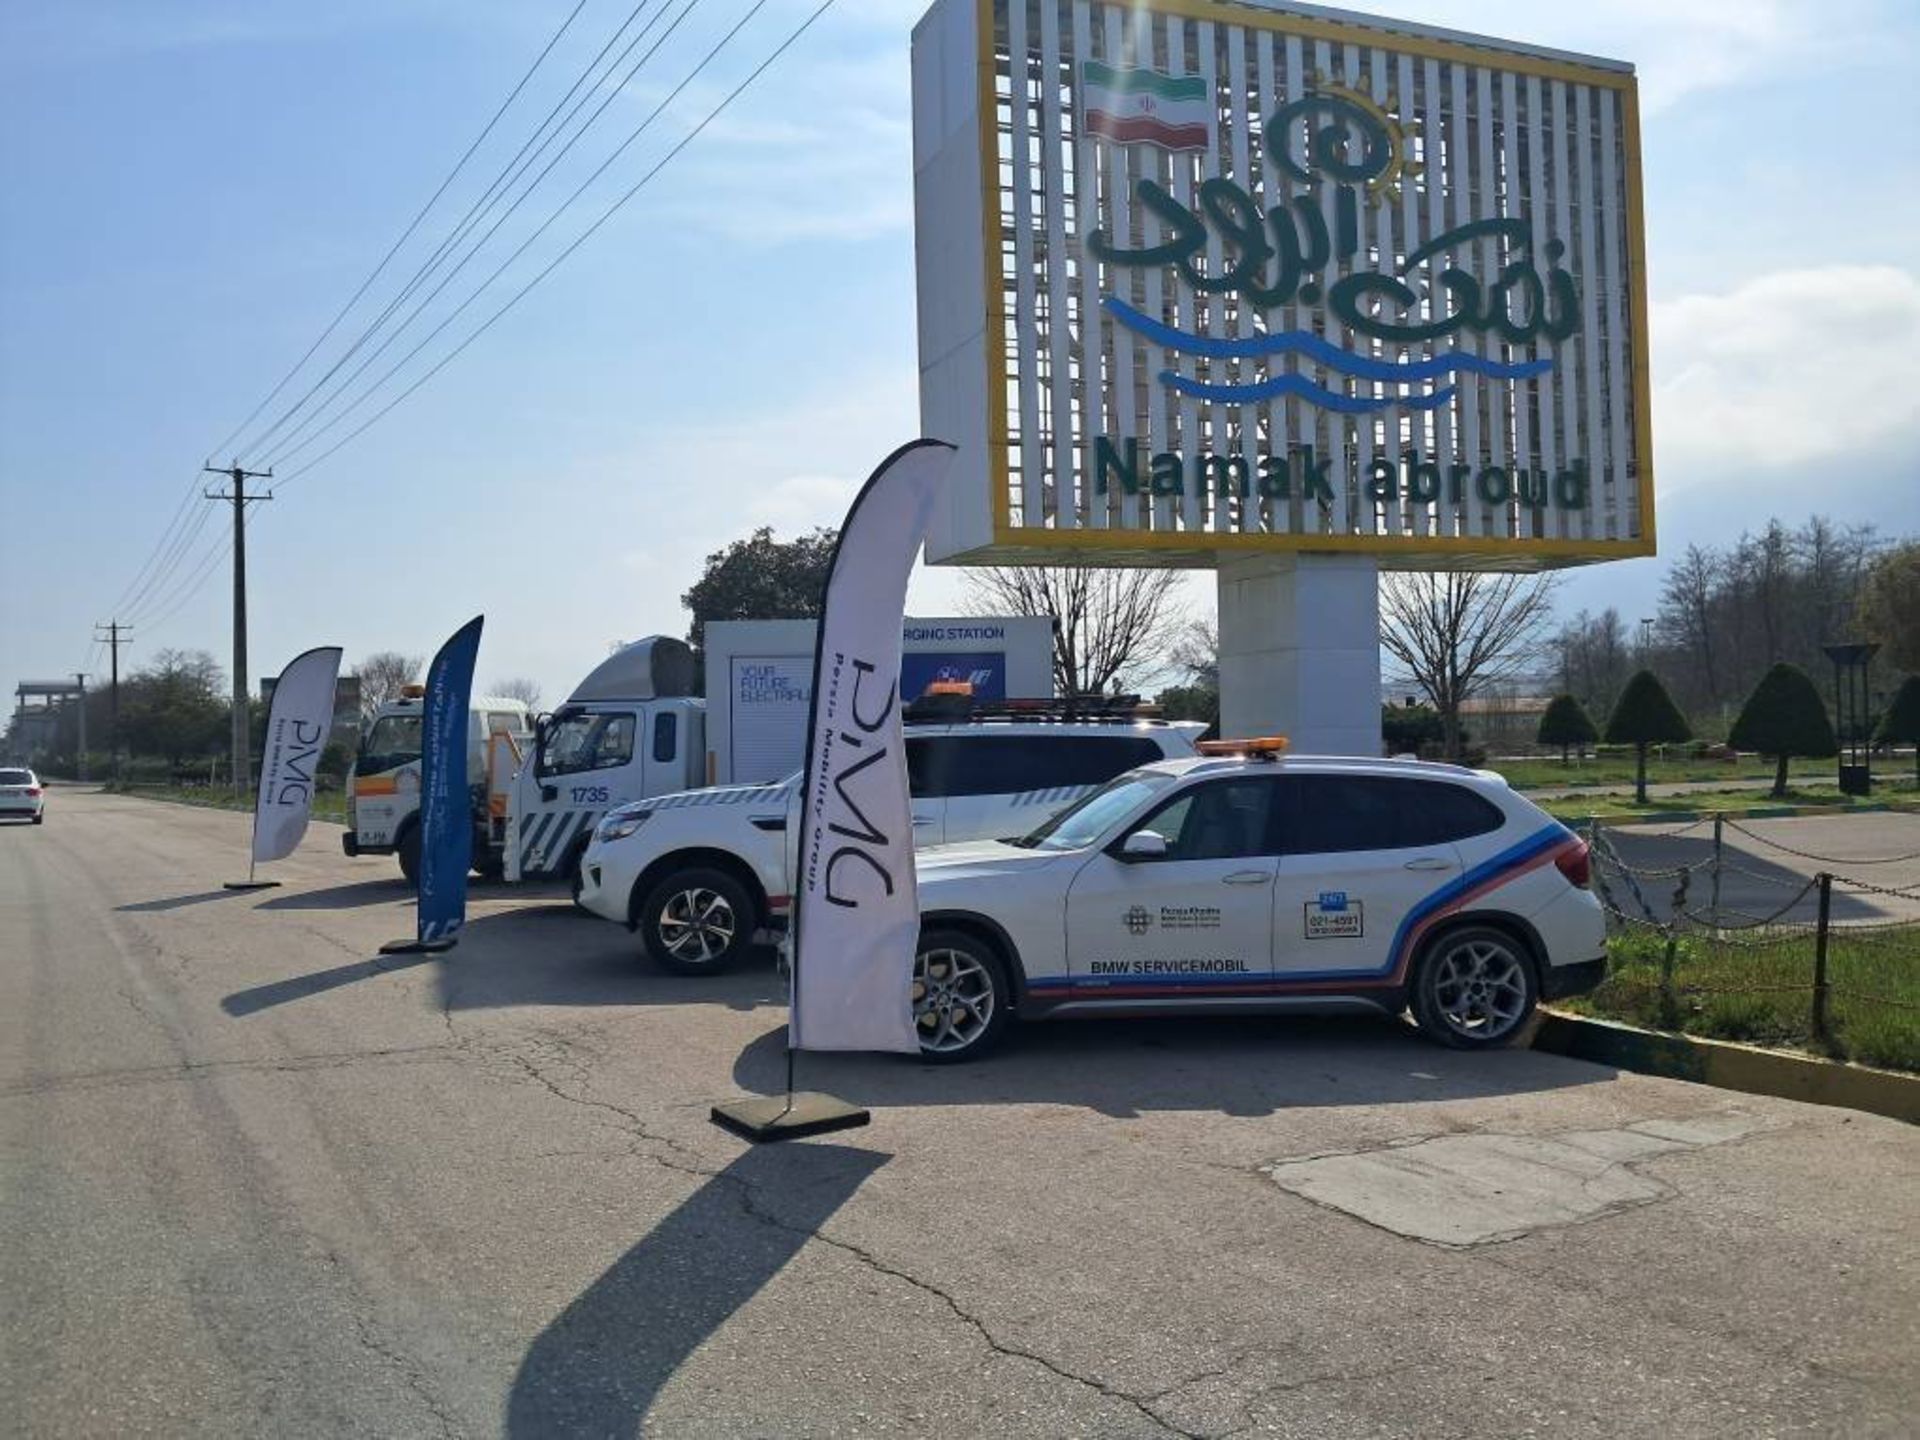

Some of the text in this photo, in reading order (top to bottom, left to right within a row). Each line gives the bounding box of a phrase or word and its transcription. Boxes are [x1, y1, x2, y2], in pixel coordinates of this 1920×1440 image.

[1093, 436, 1589, 510] Namak abroud
[903, 626, 1005, 641] RGING STATION
[741, 677, 791, 690] FUTURE
[807, 652, 845, 892] Persia Mobility Group
[571, 785, 609, 803] 1735
[1090, 959, 1251, 974] BMW SERVICEMOBIL
